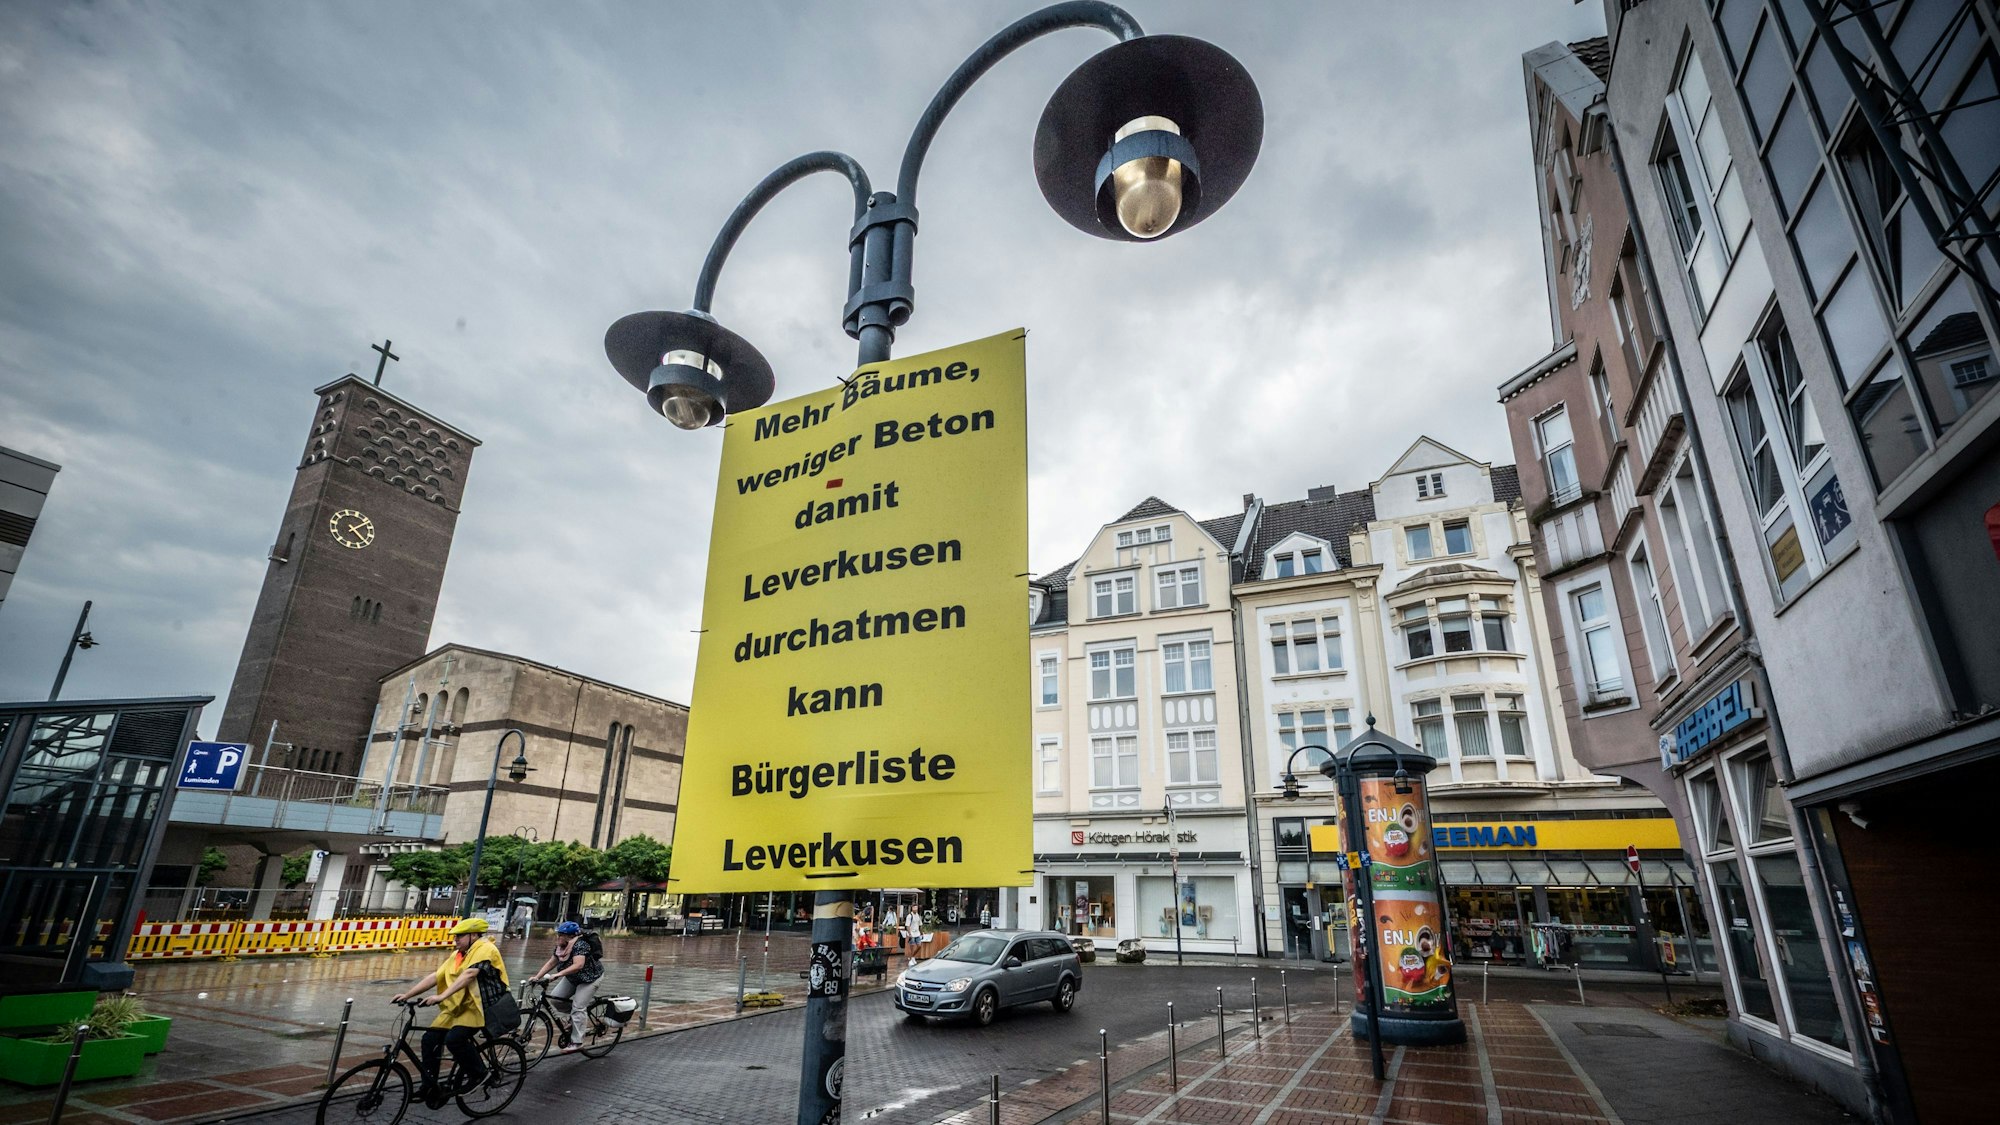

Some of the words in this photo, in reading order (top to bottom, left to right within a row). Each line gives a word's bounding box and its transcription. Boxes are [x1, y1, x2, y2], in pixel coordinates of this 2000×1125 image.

[754, 401, 835, 442] Mehr
[842, 361, 980, 411] Bäume,
[736, 433, 863, 496] weniger
[874, 408, 996, 449] Beton
[794, 480, 900, 530] damit
[743, 539, 962, 602] Leverkusen
[734, 604, 966, 663] durchatmen
[787, 682, 884, 717] kann
[1675, 680, 1751, 762] HEBBEL
[216, 751, 239, 775] P
[731, 747, 956, 799] Bürgerliste
[723, 832, 963, 872] Leverkusen
[1088, 831, 1131, 847] Köttgen
[1135, 830, 1197, 843] Hörakstik
[1432, 826, 1538, 847] EEMAN
[824, 980, 839, 995] 89
